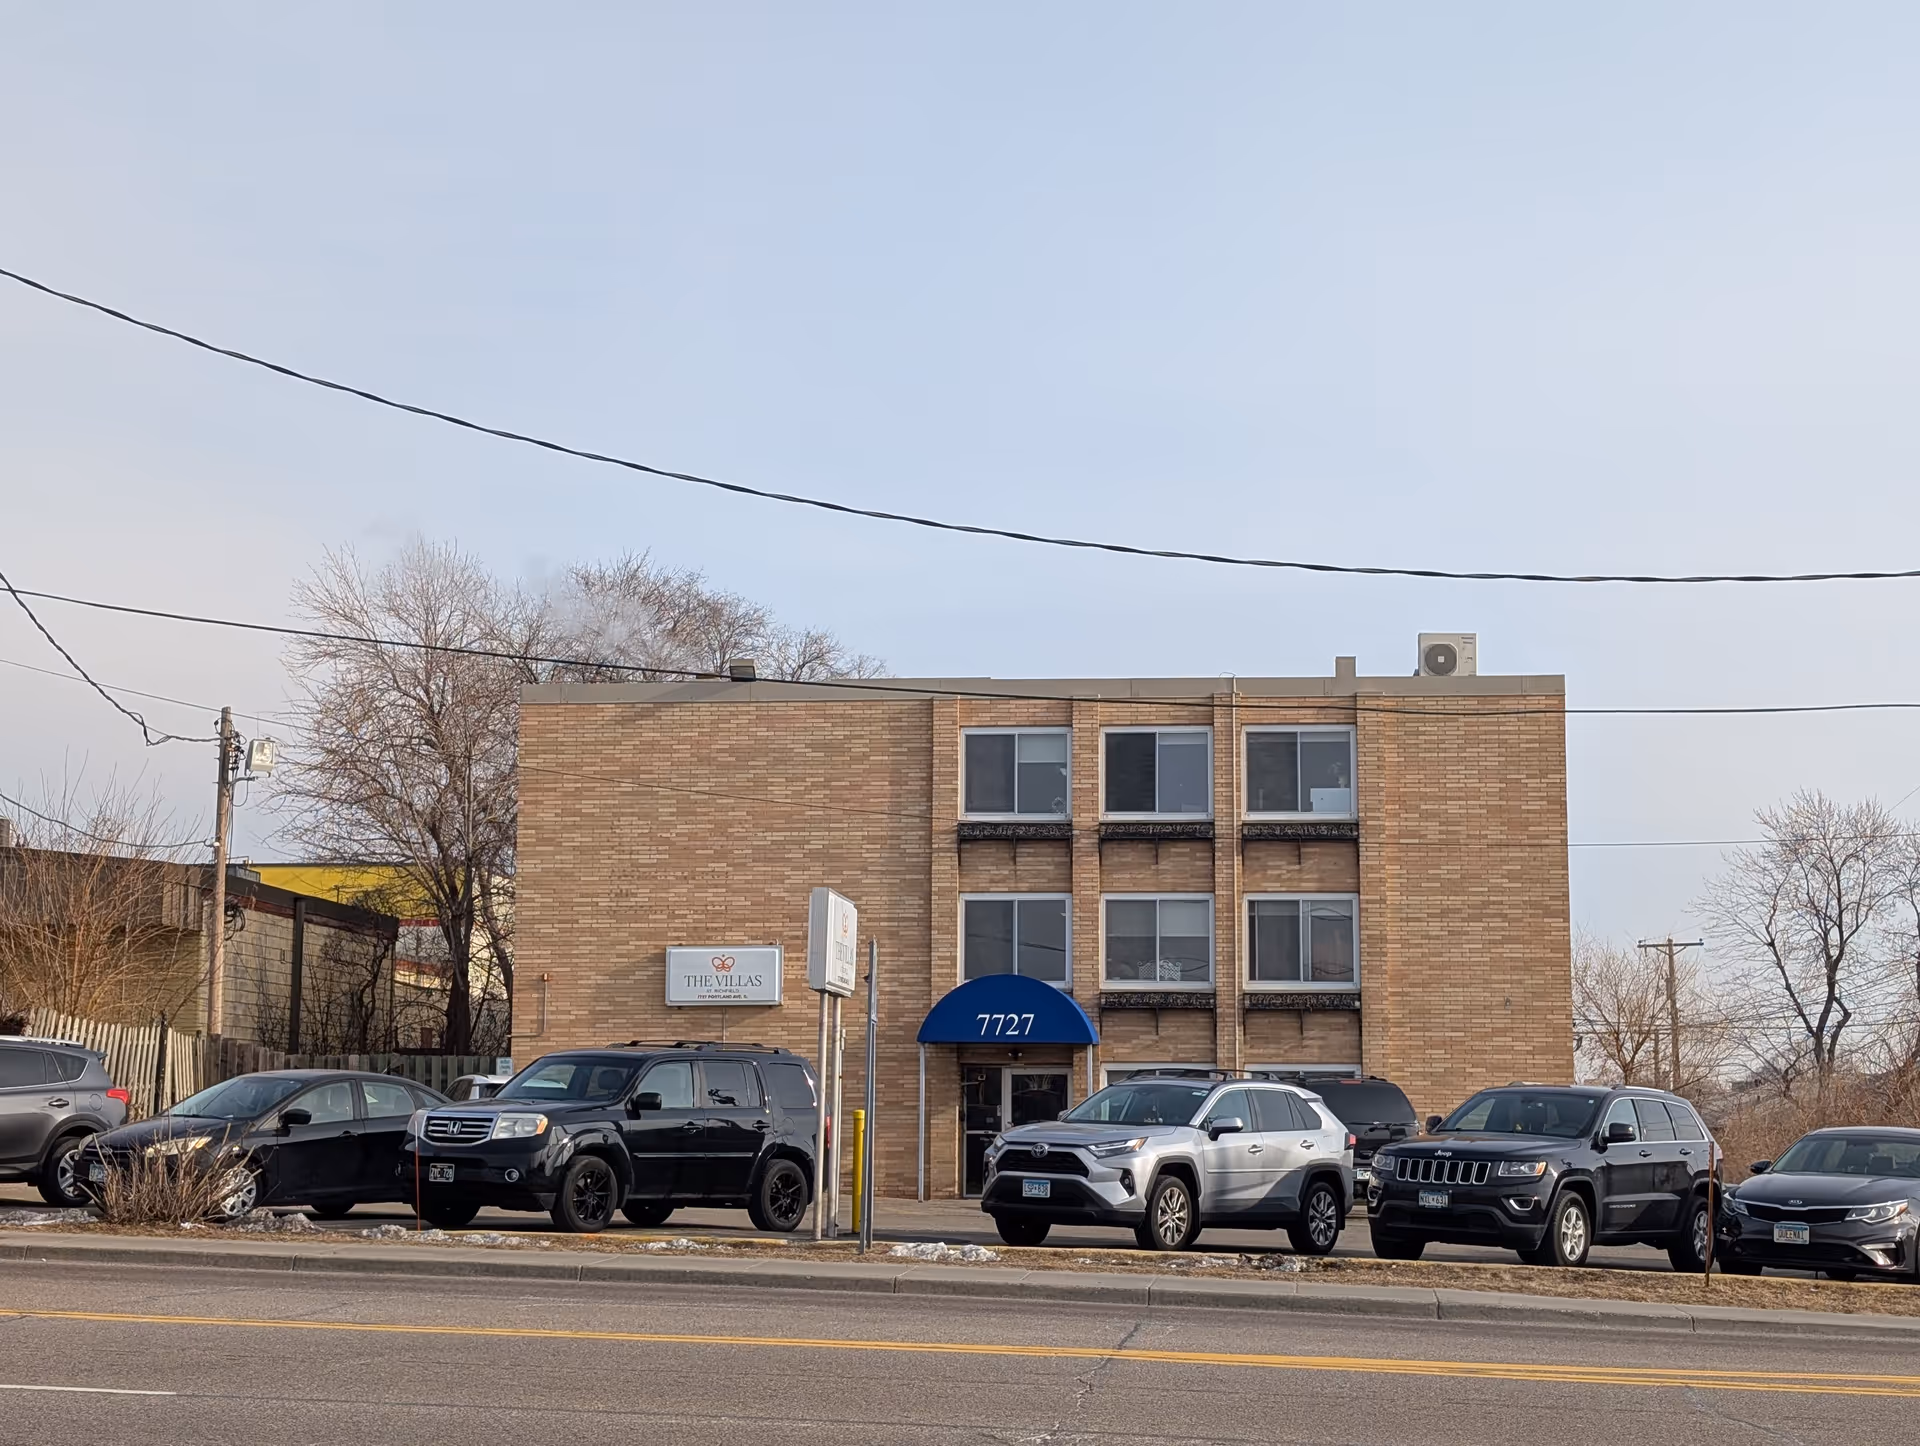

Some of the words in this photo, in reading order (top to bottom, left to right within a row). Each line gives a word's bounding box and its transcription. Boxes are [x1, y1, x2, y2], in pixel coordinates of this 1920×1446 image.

[684, 975, 713, 988] THE
[715, 974, 762, 987] VILLAS
[976, 1013, 1035, 1036] 7727
[1434, 1149, 1452, 1158] Jeep
